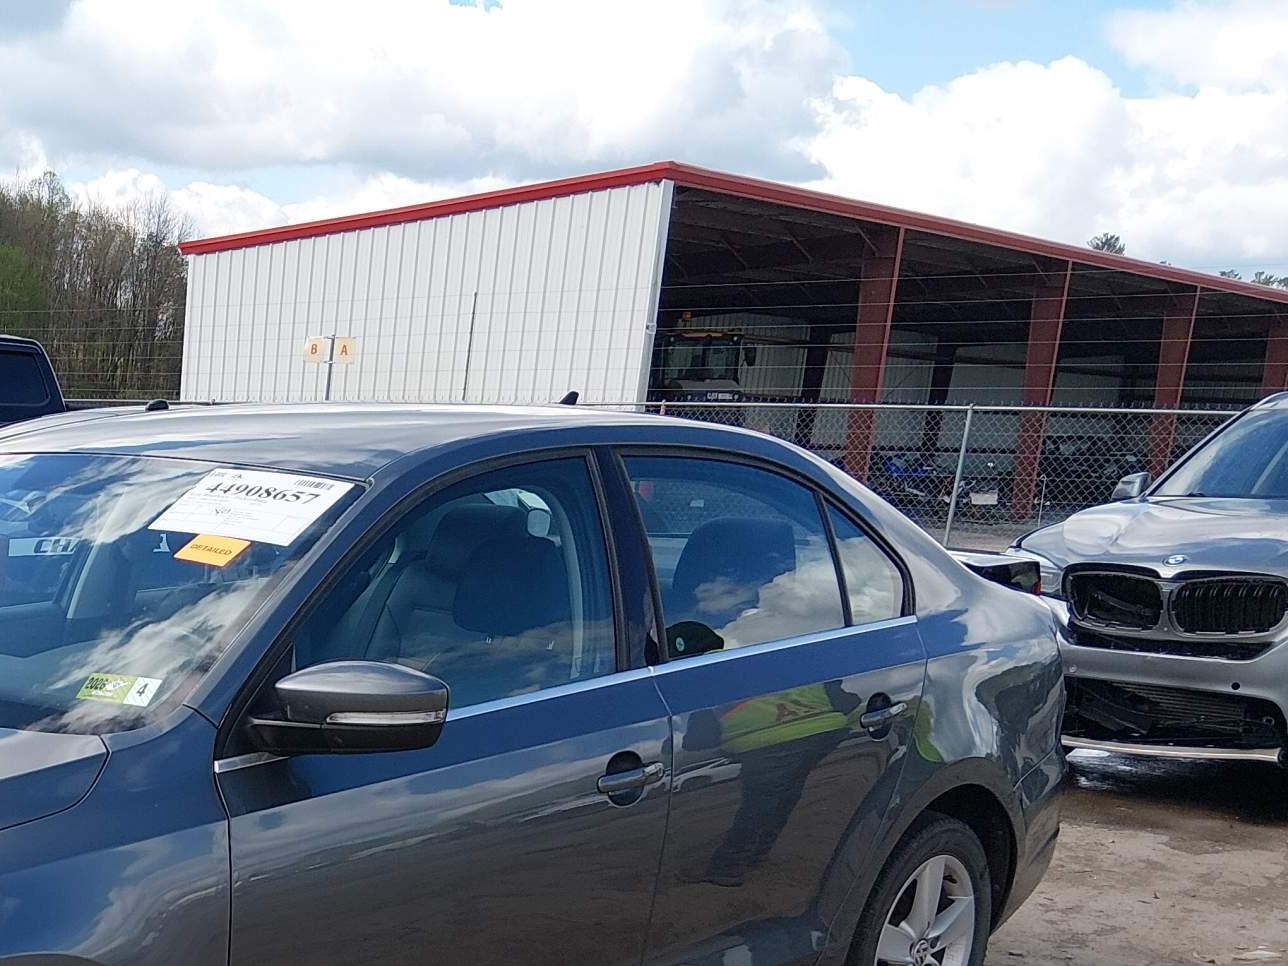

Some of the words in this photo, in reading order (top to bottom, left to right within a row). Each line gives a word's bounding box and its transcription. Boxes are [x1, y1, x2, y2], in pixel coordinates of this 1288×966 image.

[310, 343, 318, 355] B
[340, 344, 348, 356] A
[205, 482, 321, 505] 44908657
[190, 543, 233, 556] DETAILED
[136, 682, 149, 697] 4
